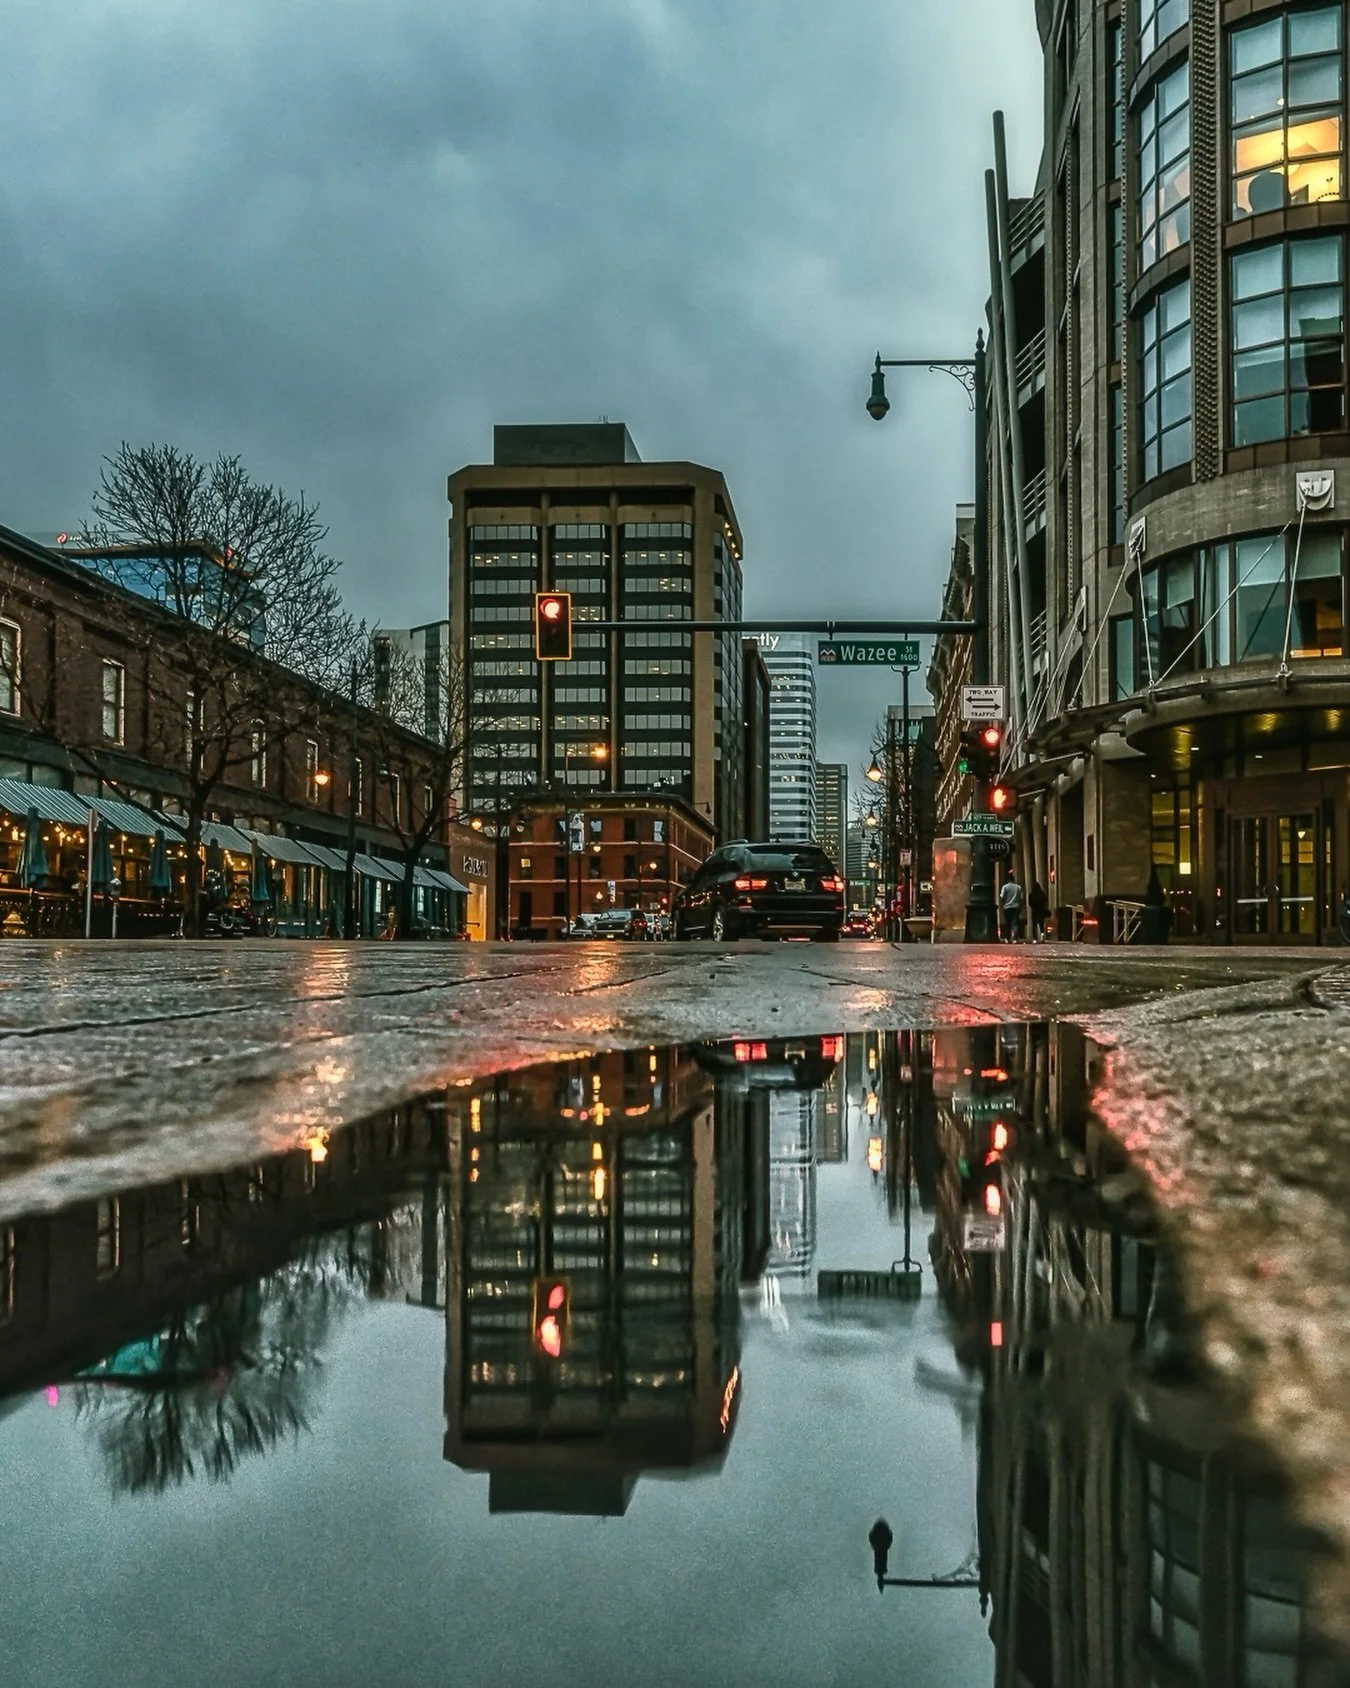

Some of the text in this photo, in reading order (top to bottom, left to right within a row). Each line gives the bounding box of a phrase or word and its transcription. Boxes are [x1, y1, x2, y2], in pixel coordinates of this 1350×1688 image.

[840, 645, 897, 661] Wazee
[900, 653, 919, 661] 1600
[963, 823, 982, 833] JACK
